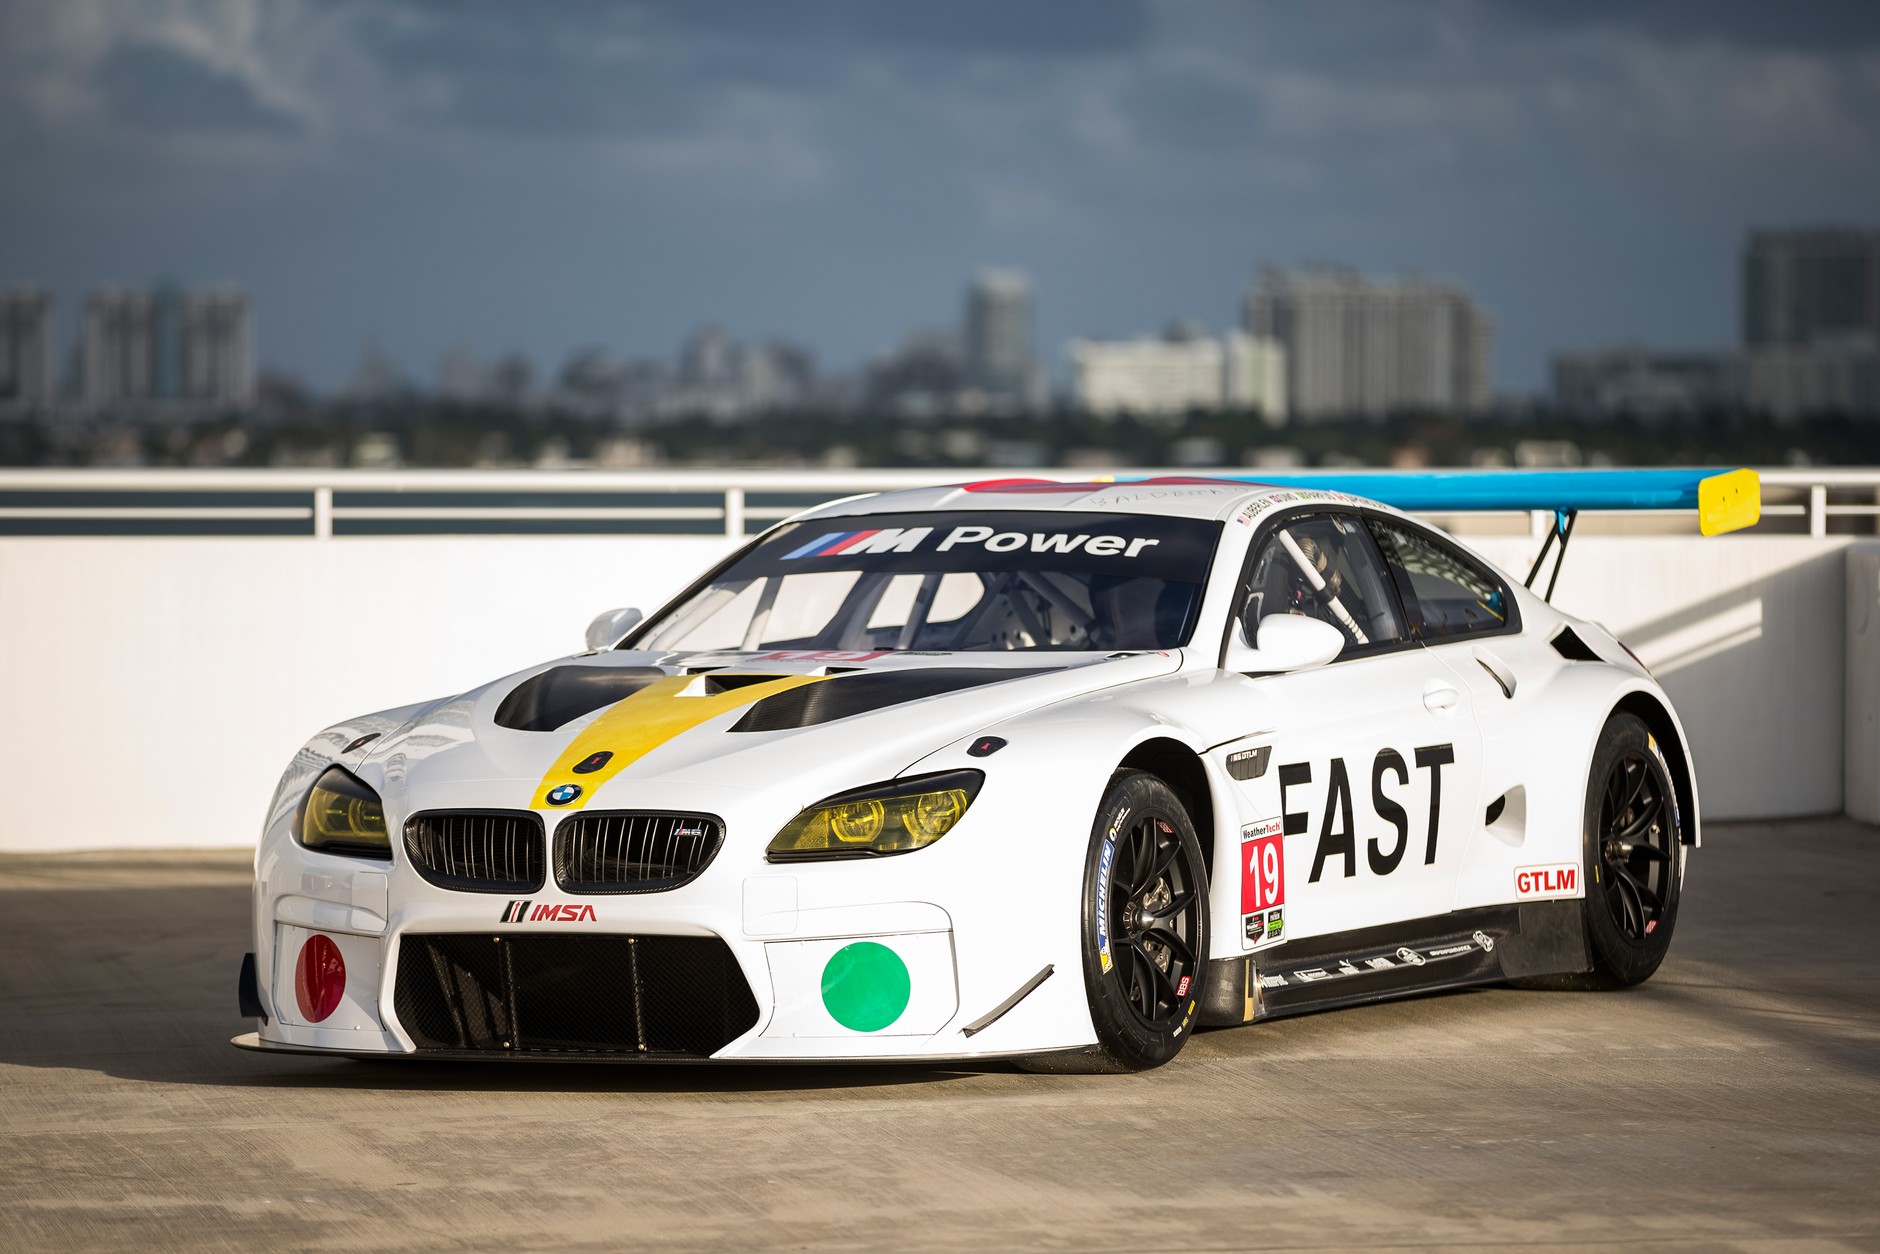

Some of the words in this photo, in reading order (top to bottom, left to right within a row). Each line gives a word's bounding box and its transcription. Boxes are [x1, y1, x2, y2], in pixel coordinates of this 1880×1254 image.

[837, 527, 934, 556] M
[936, 526, 1160, 558] Power
[1278, 743, 1455, 883] FAST
[1243, 822, 1281, 840] WeatherTech
[1249, 842, 1279, 908] 19
[1517, 869, 1575, 893] GTLM
[1098, 843, 1112, 937] MICHELIN
[530, 904, 597, 922] IMSA
[1177, 977, 1190, 996] BBS
